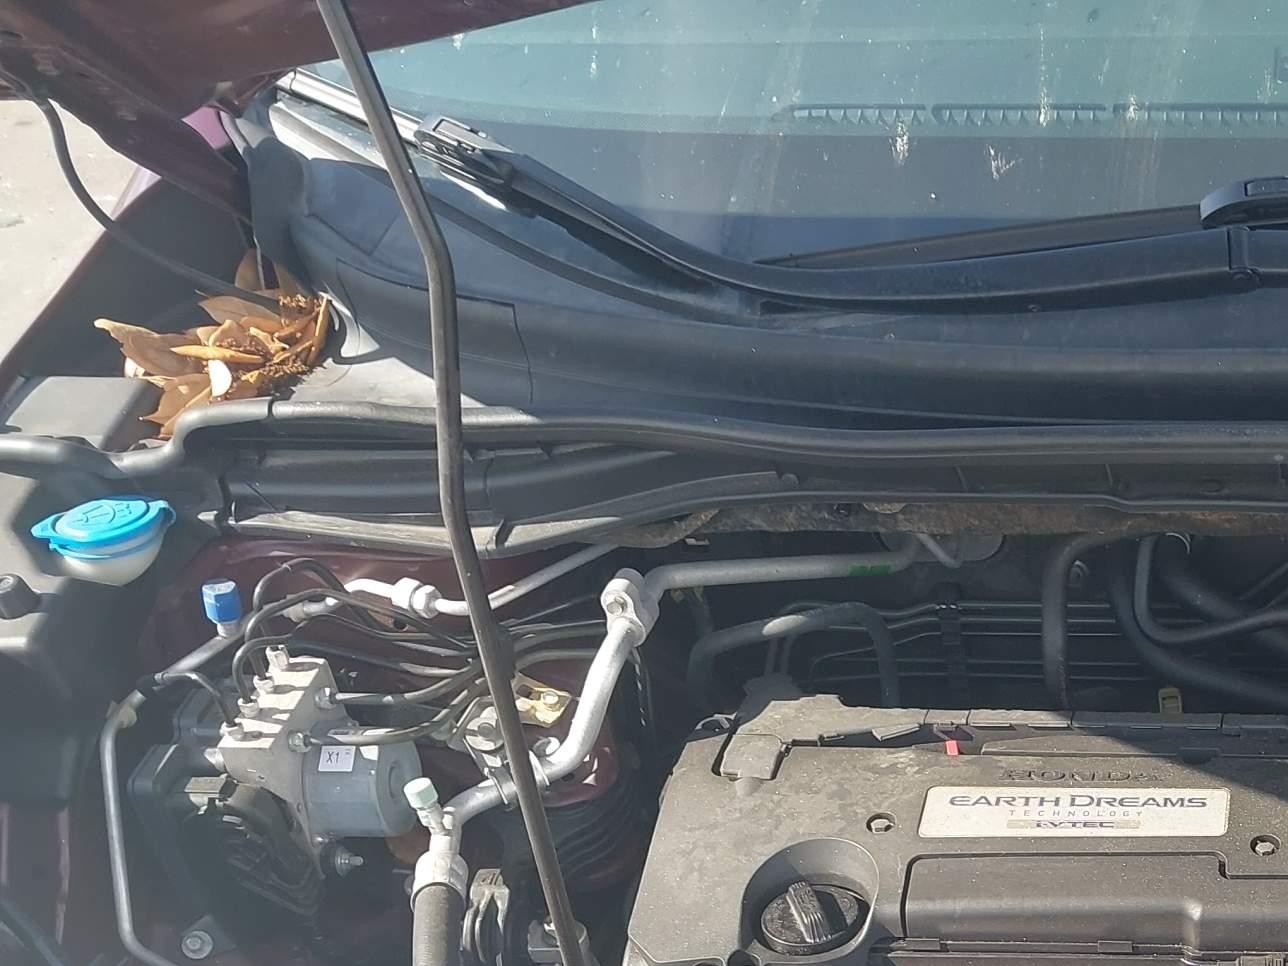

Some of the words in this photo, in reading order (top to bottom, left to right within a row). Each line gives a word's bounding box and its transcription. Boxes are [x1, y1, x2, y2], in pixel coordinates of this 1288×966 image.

[325, 751, 340, 763] X1
[949, 795, 1060, 806] EARTH
[1069, 794, 1208, 807] DREAMS
[1009, 809, 1142, 817] TECHNOLOGY
